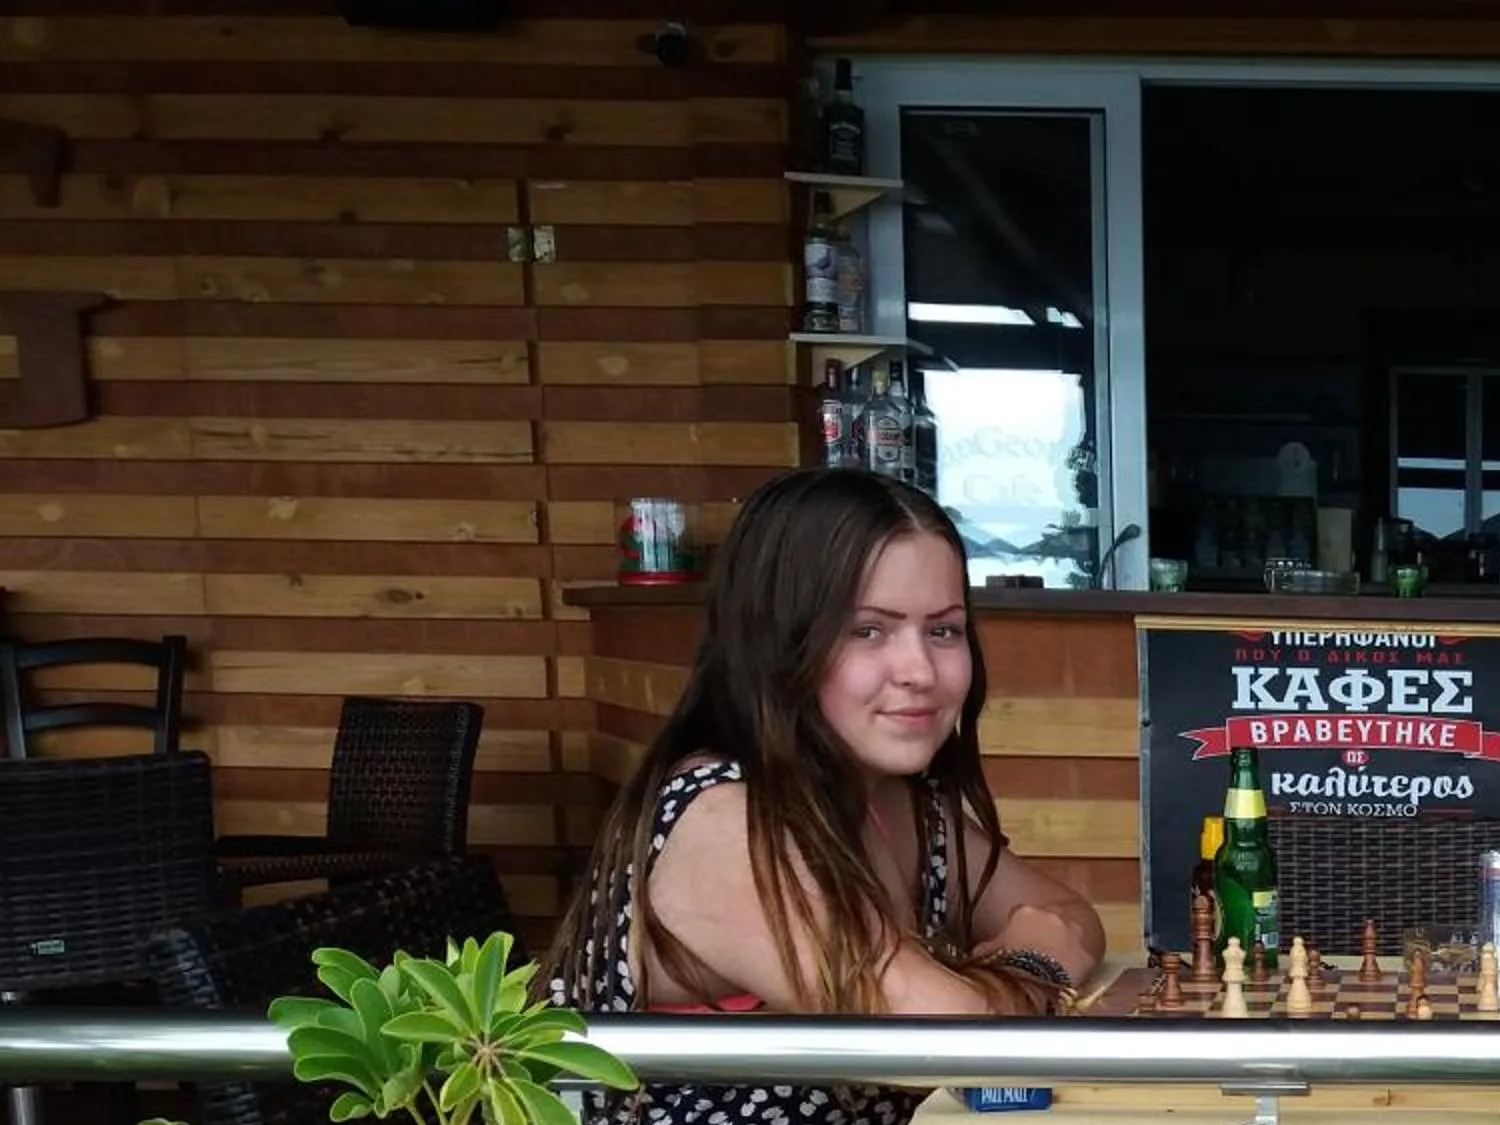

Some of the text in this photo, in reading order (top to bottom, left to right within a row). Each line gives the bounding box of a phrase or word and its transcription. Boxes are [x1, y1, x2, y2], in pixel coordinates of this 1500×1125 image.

[1231, 666, 1473, 714] ΚΑΦΕΣ
[1249, 719, 1458, 748] ΒΡΑΒΕΥΤΗΚΕ
[1271, 765, 1474, 805] καλύτερος
[1289, 801, 1418, 818] ΣΤΟΝ ΚΟΣΜΟ
